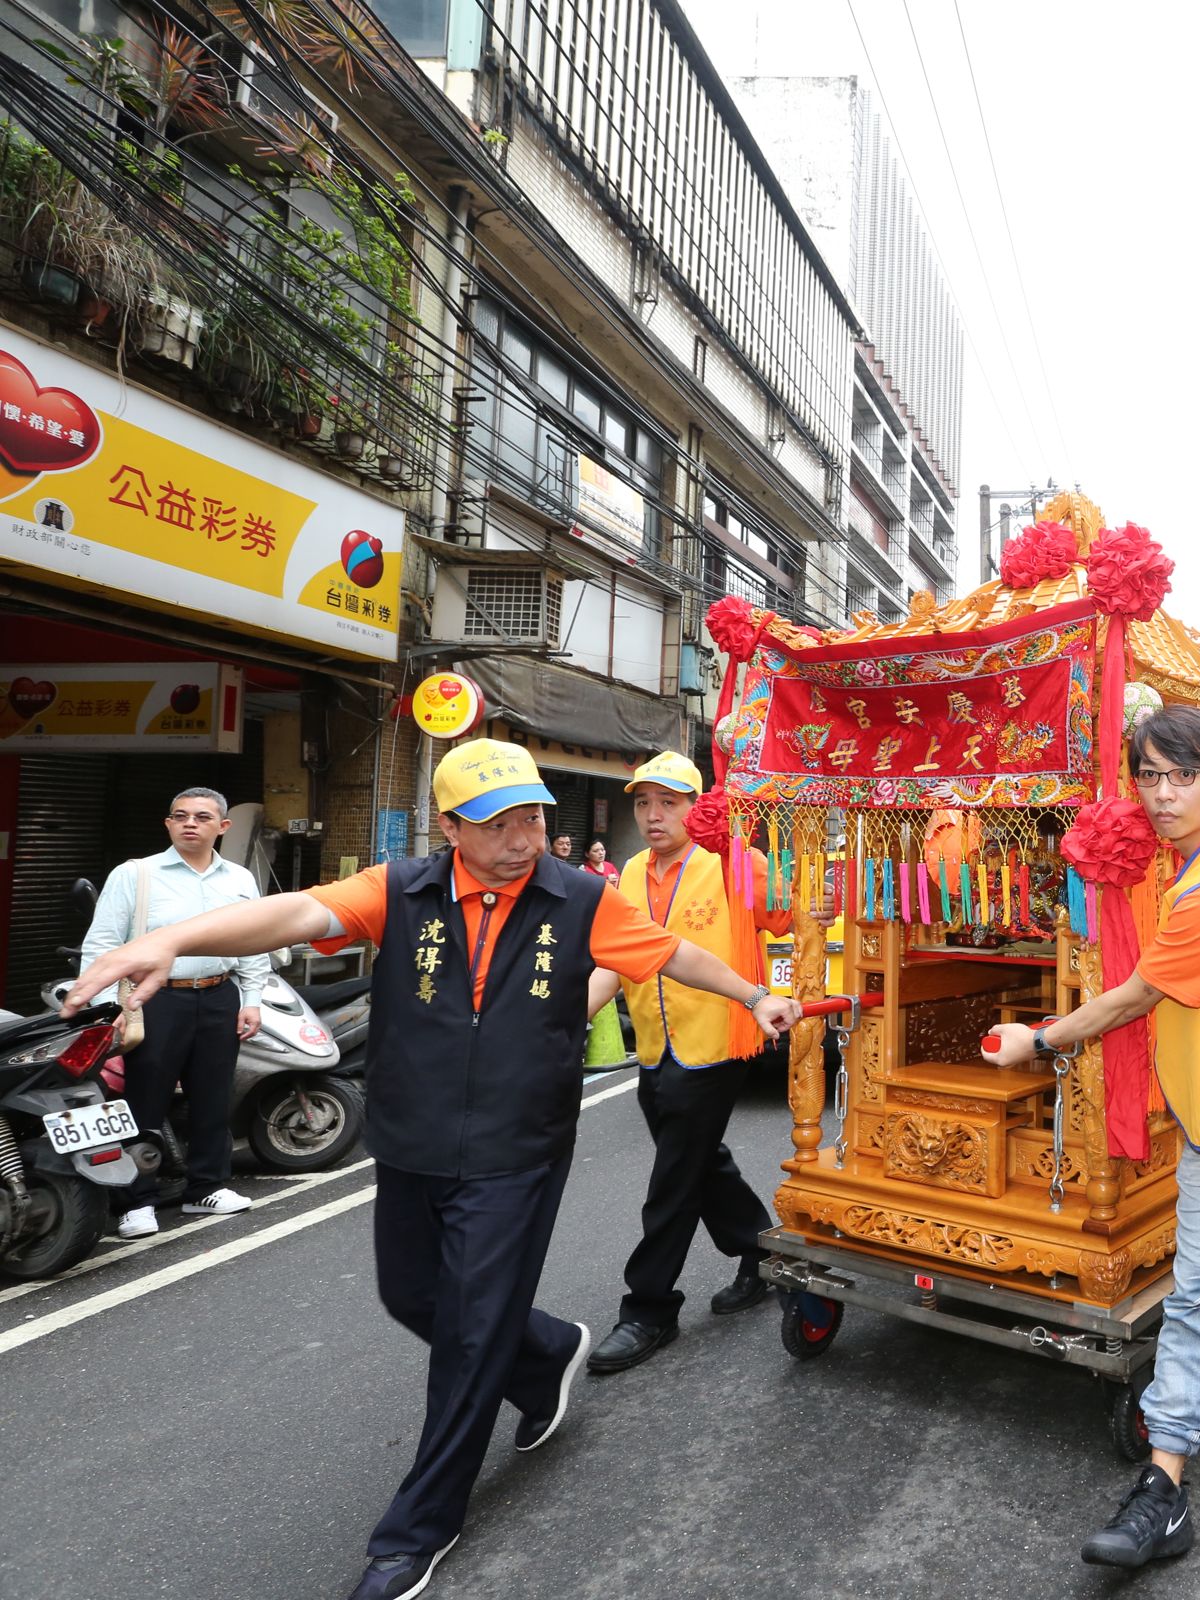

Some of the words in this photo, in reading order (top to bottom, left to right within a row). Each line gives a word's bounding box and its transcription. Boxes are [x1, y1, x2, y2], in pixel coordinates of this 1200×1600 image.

[107, 463, 277, 558] 公益彩券
[58, 699, 131, 718] 公益彩券
[414, 918, 446, 1004] 沈得壽
[529, 923, 558, 999] 基隆媽
